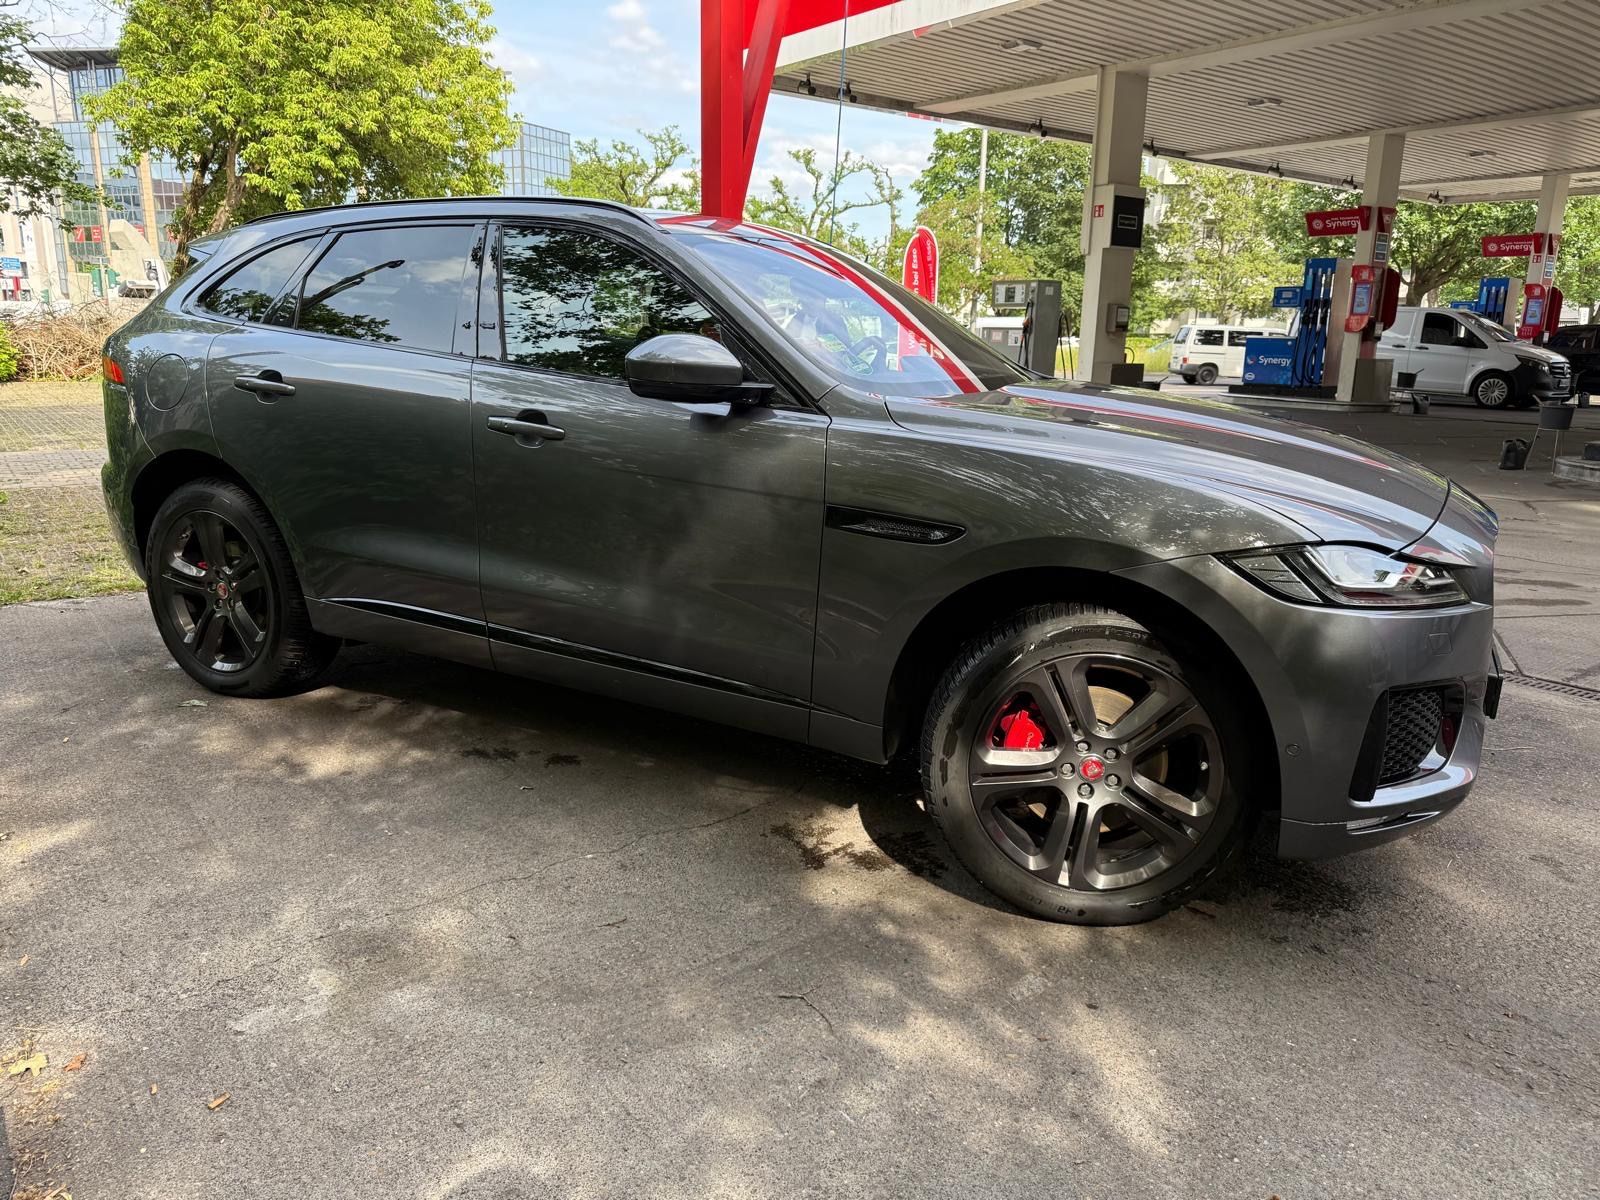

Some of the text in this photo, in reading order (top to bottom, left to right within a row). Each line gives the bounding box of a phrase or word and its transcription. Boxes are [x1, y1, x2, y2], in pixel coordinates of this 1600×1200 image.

[1325, 219, 1360, 229] Synergy
[1500, 243, 1532, 252] Synergy
[911, 248, 919, 269] Esso
[1258, 355, 1292, 367] Synergy
